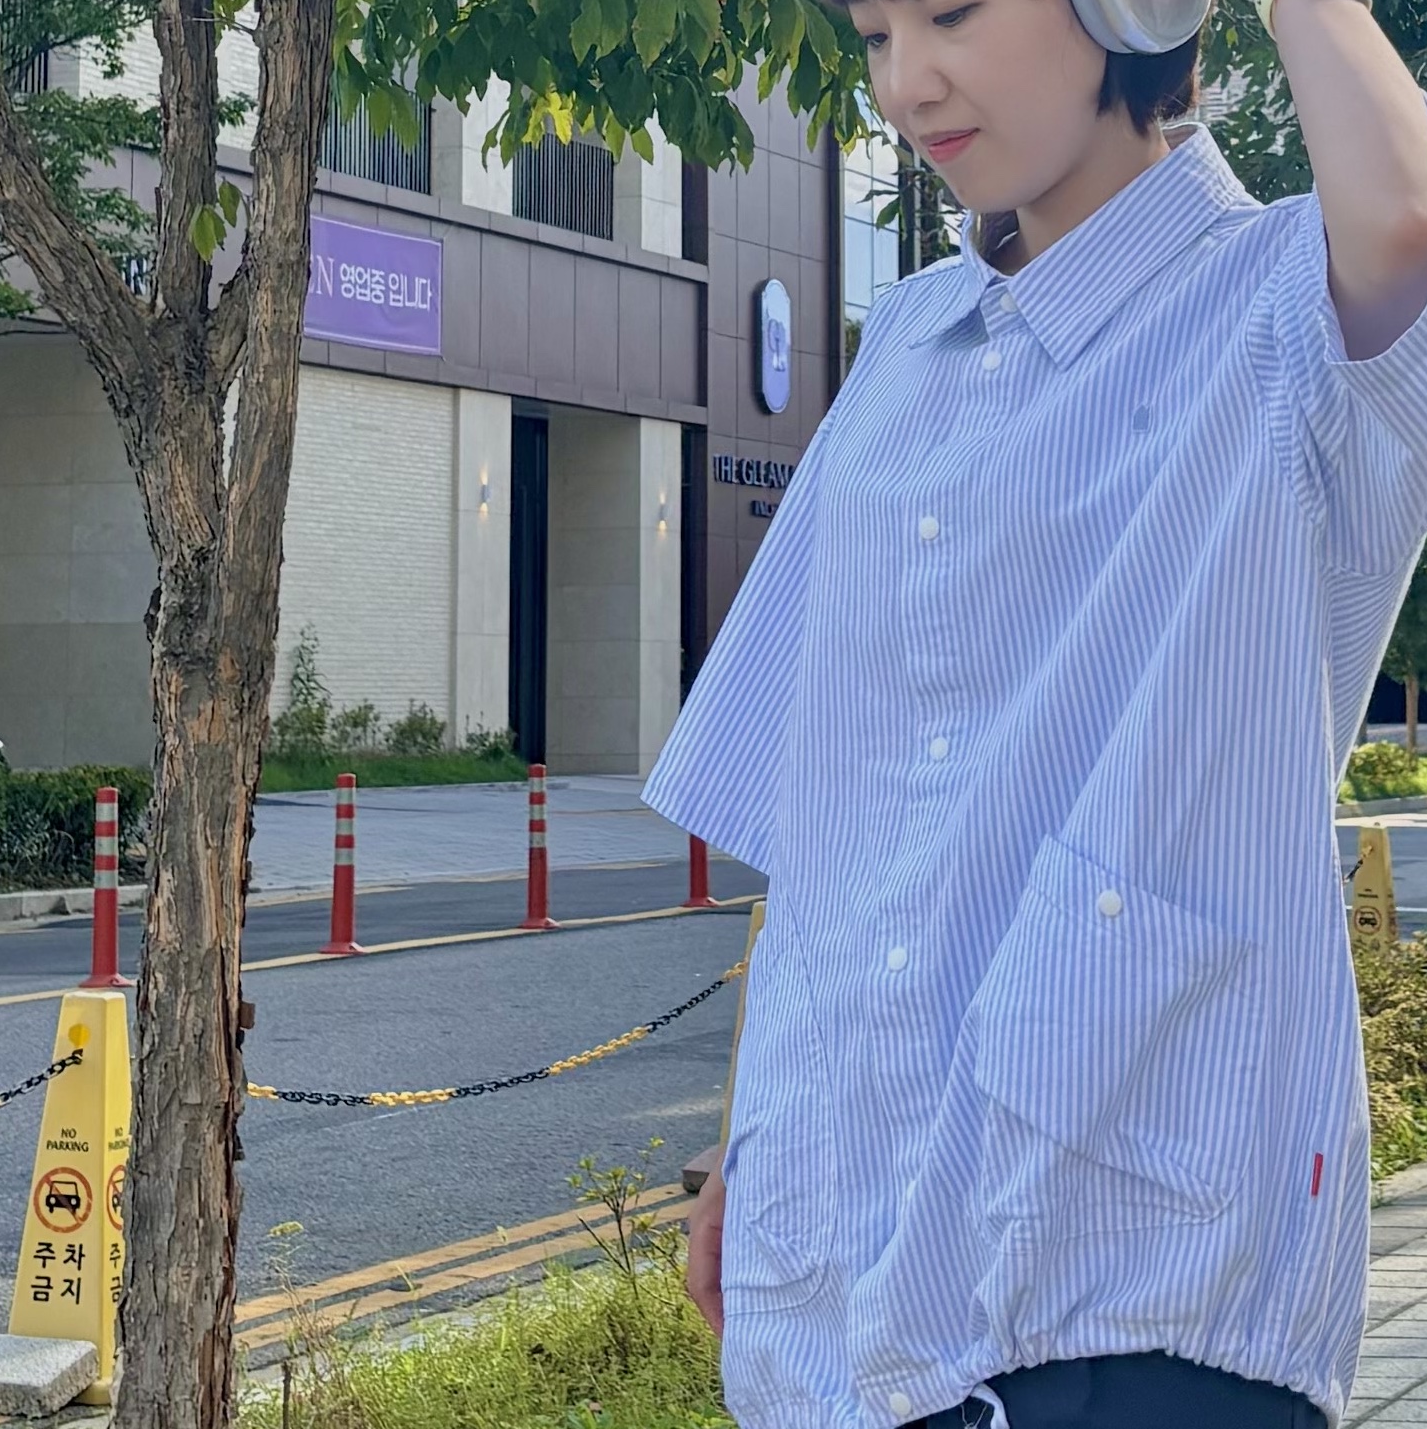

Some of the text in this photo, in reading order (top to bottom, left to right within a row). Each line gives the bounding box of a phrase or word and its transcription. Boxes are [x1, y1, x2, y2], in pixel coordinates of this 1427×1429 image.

[339, 262, 433, 312] 영업중 입니다
[713, 454, 739, 484] THE
[45, 1139, 89, 1153] PARKING
[60, 1128, 77, 1139] NO
[33, 1241, 86, 1272] 주차
[30, 1275, 82, 1306] 금지
